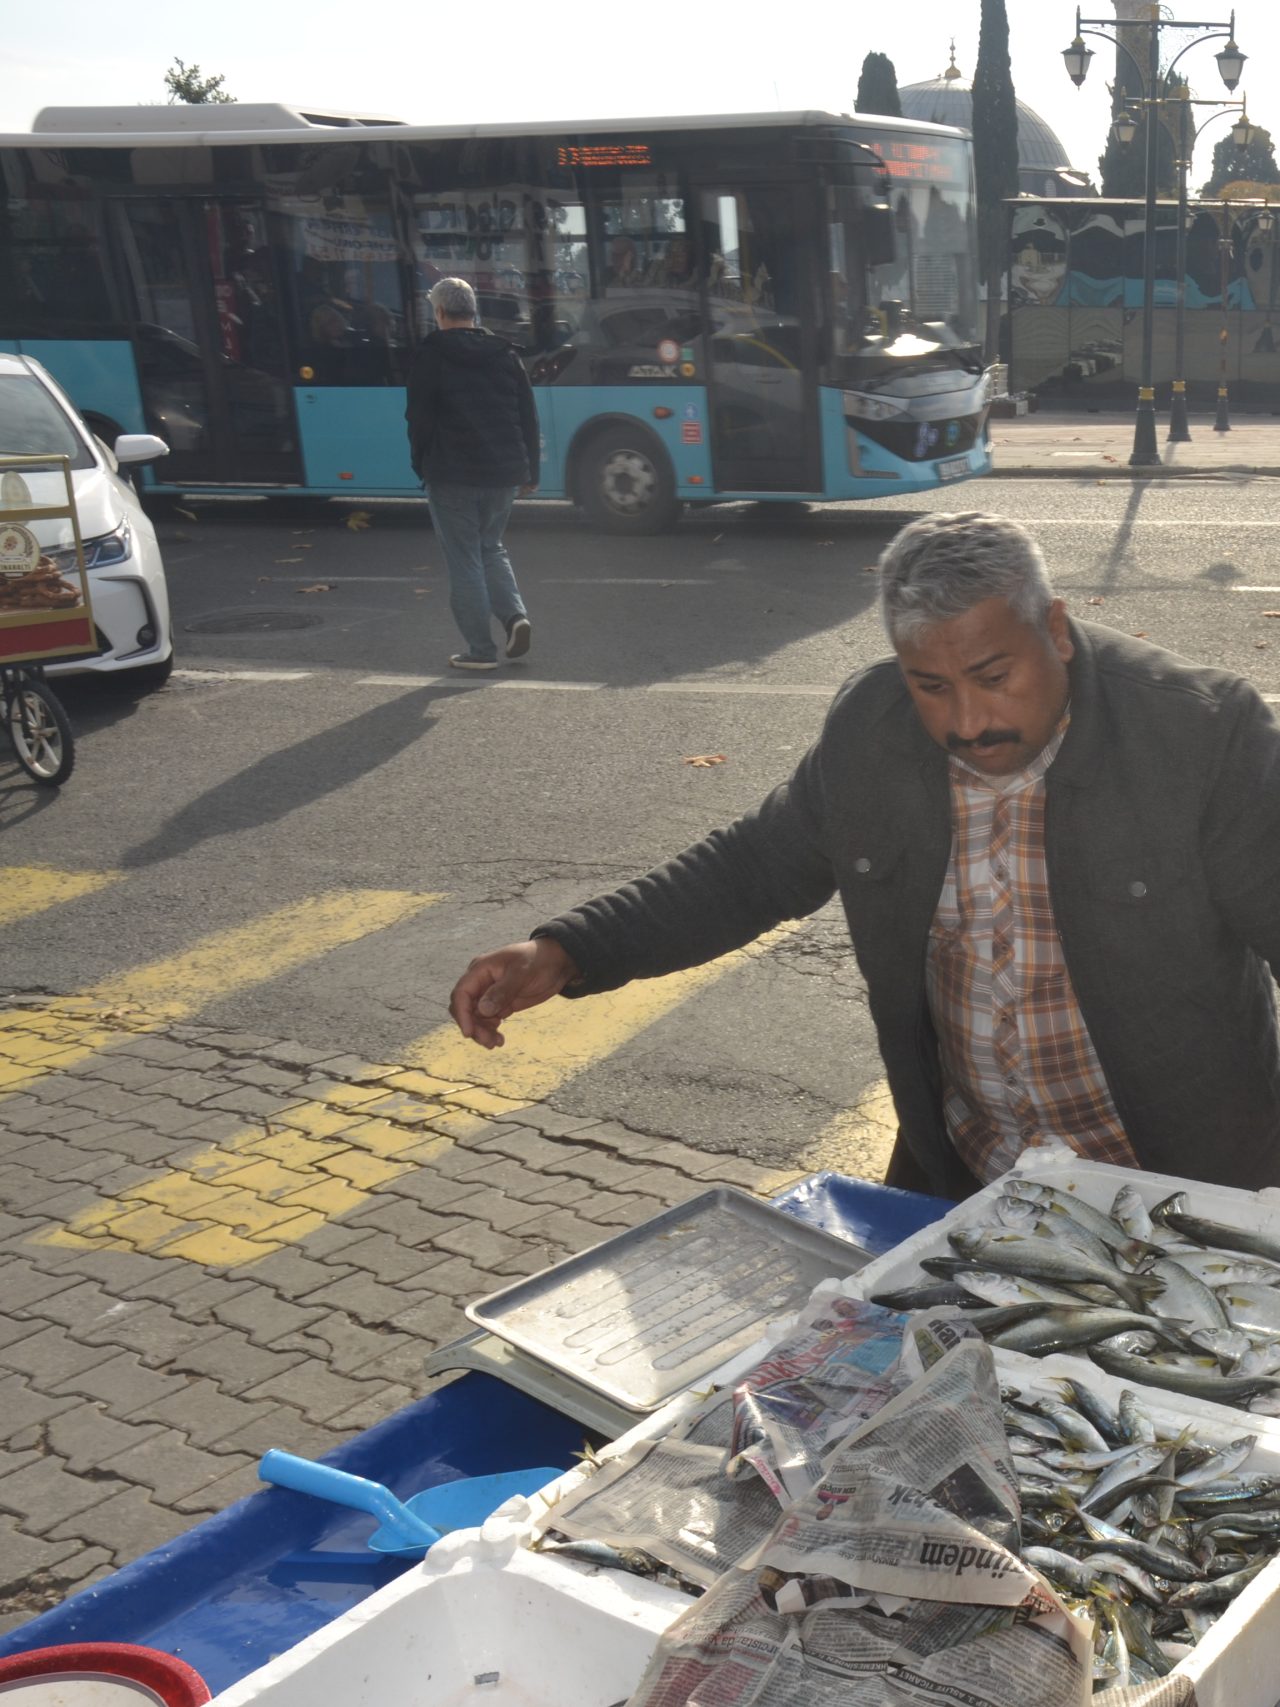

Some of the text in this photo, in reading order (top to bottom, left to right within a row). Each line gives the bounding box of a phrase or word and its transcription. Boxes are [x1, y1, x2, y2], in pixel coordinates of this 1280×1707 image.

[628, 364, 678, 377] ATAK
[898, 1668, 935, 1692] TİCARET
[935, 1684, 965, 1699] ASLİYE
